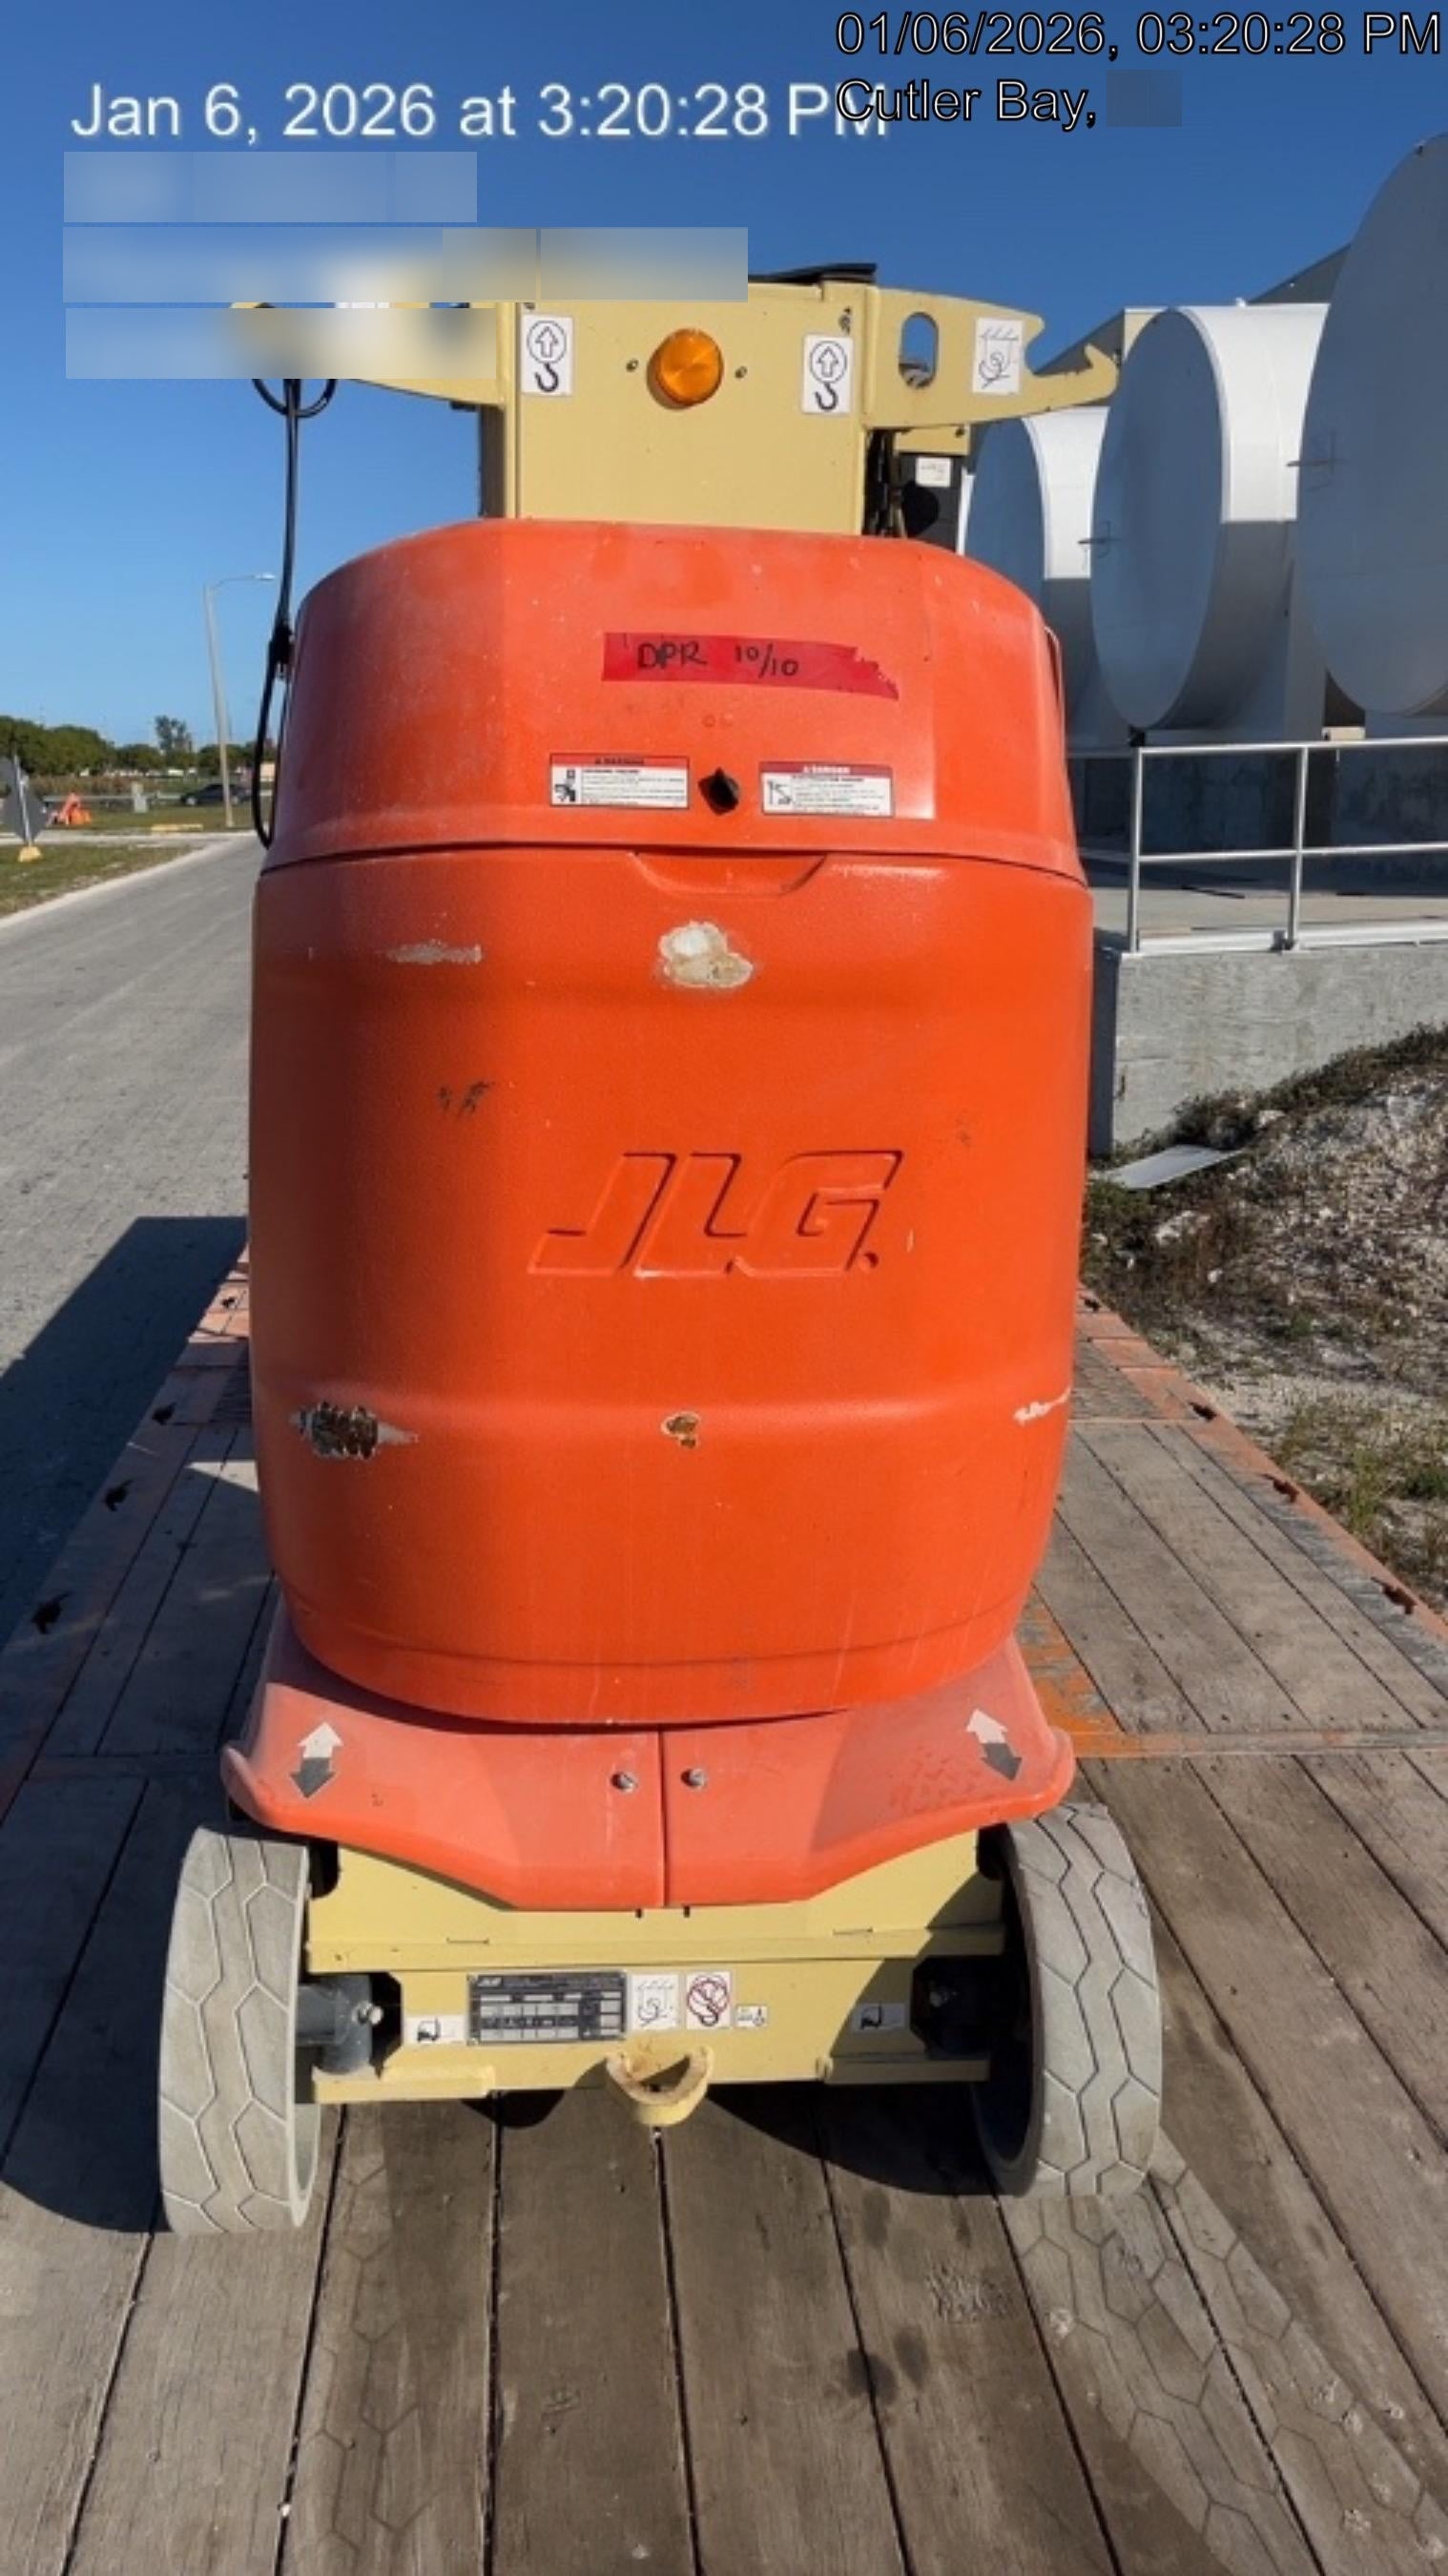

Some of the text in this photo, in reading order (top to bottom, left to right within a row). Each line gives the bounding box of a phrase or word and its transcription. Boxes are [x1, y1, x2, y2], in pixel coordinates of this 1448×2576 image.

[637, 640, 799, 678] DPR 10/10
[527, 1151, 904, 1278] JLG
